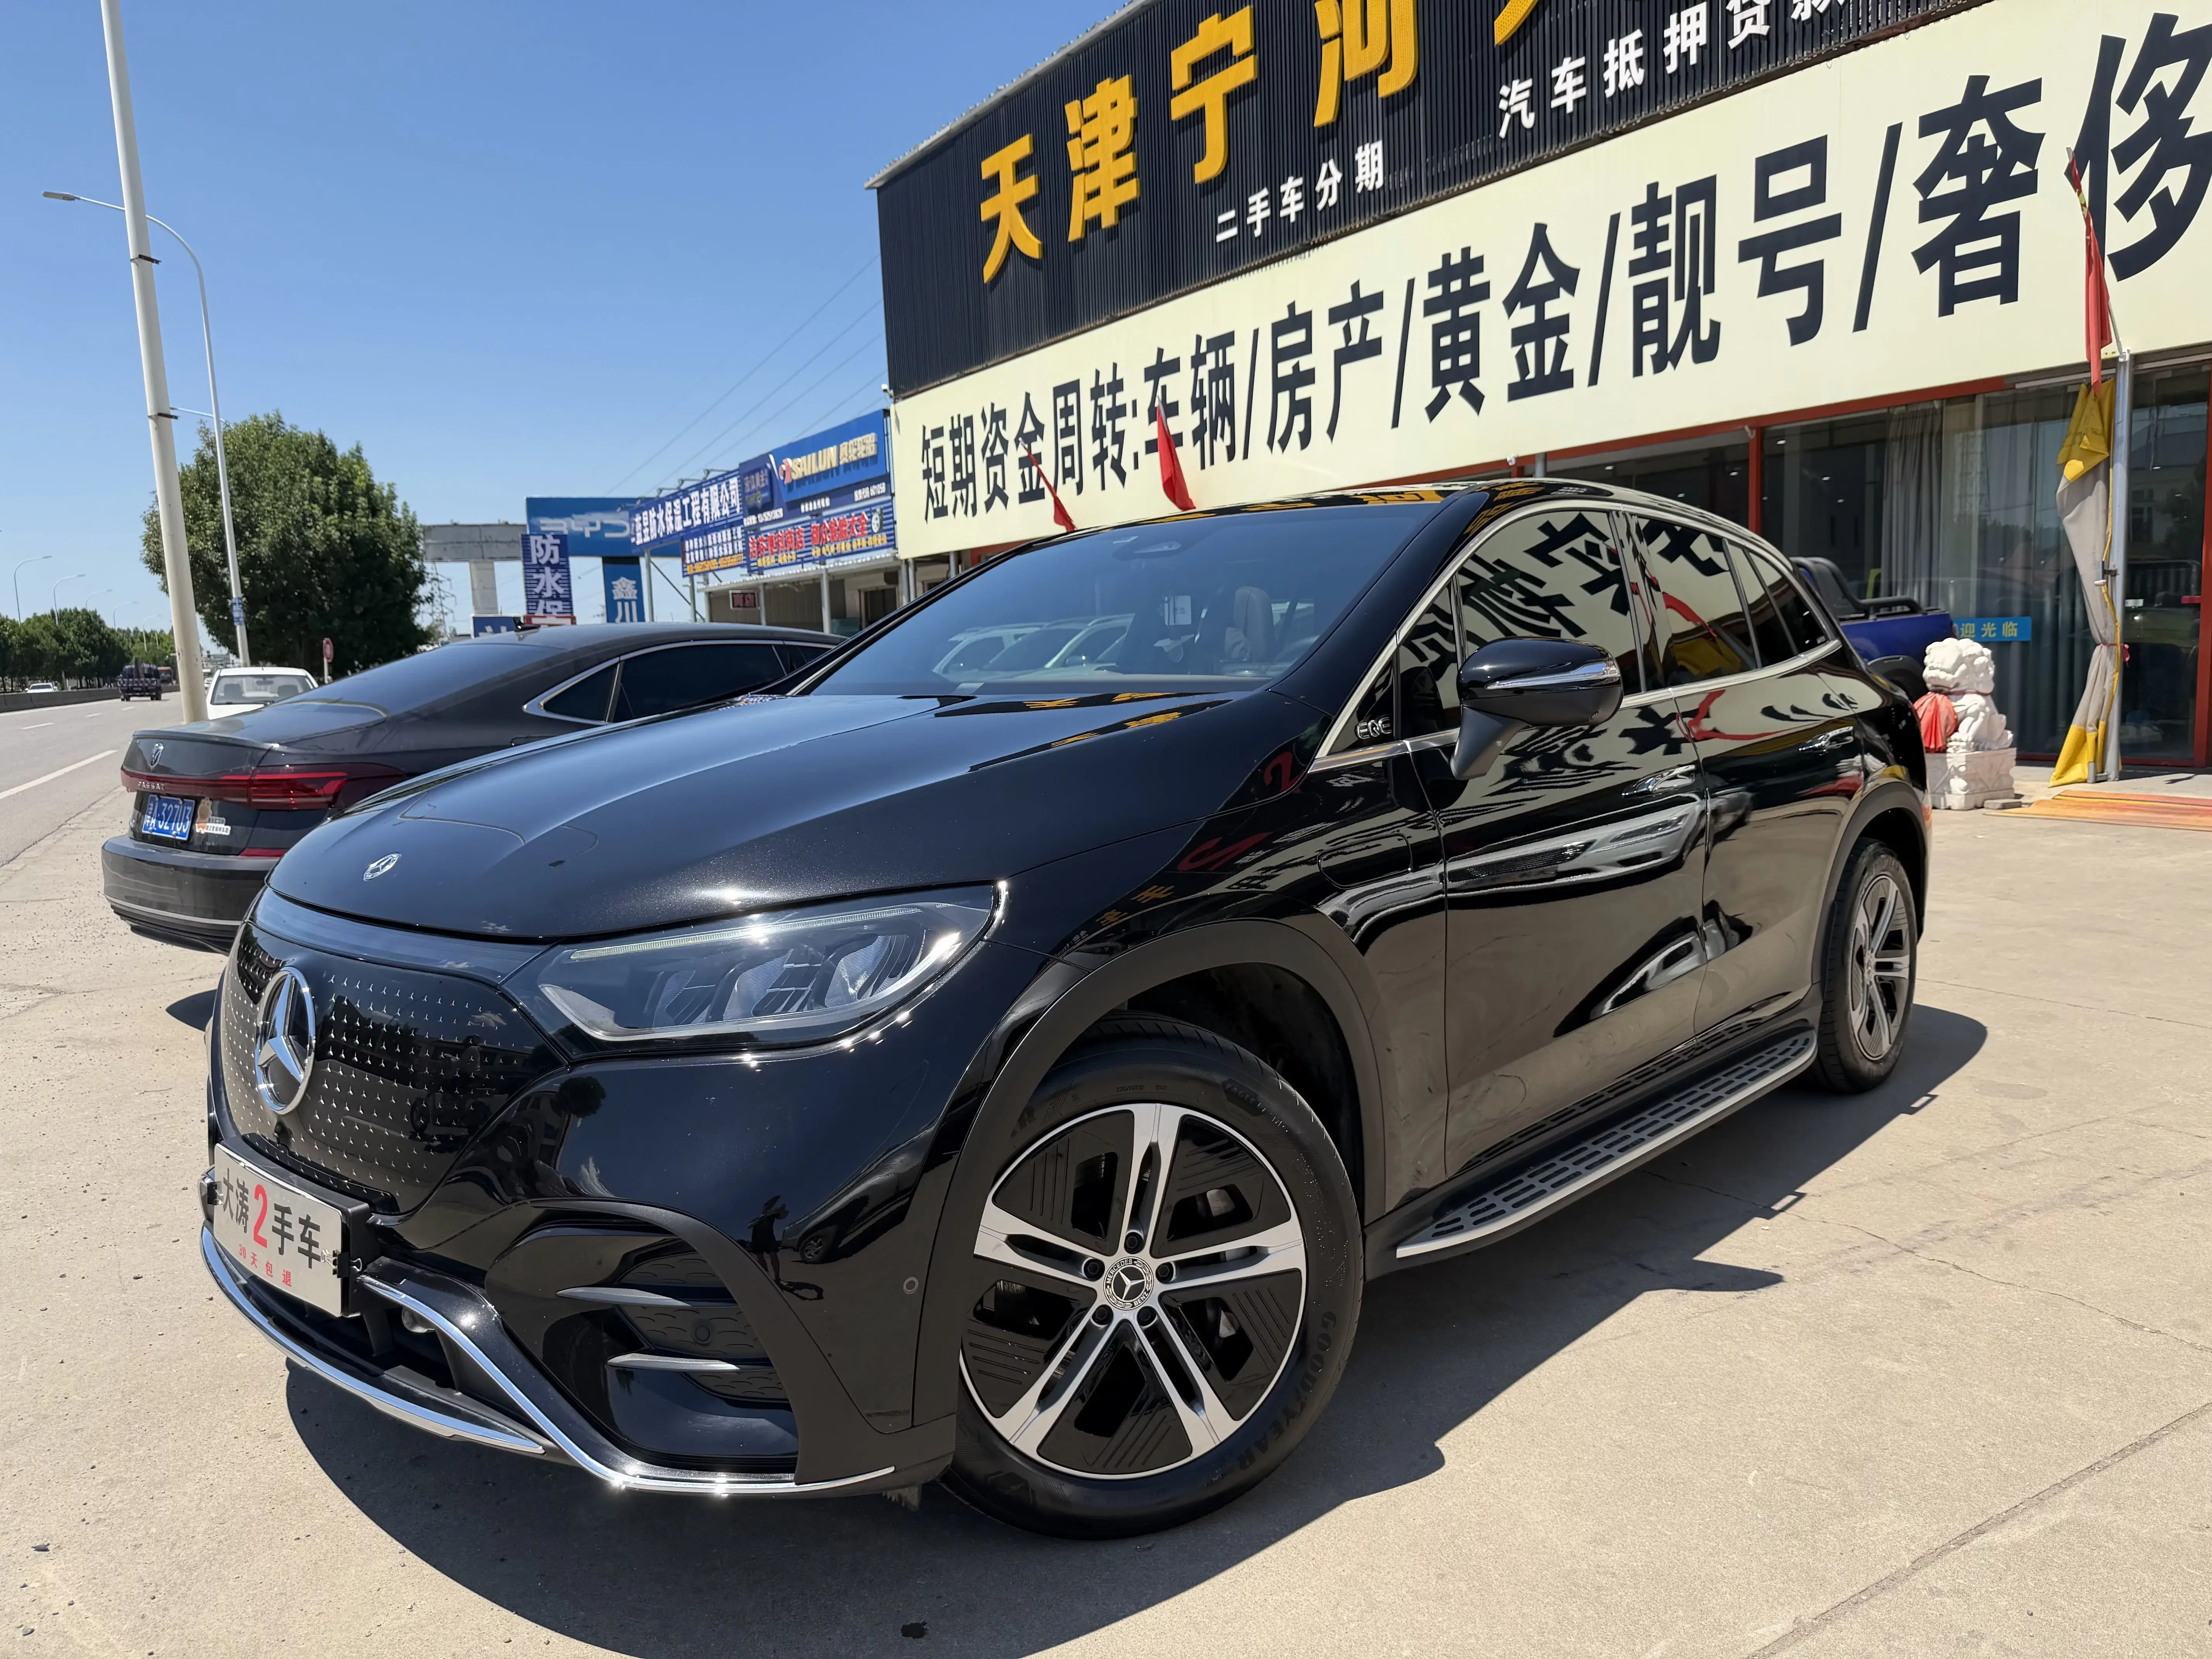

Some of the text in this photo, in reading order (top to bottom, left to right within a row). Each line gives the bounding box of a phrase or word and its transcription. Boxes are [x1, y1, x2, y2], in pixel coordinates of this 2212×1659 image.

[981, 0, 1538, 283] 天津宁河
[1215, 139, 1384, 244] 二手车分期
[791, 445, 838, 480] SAILUN
[1357, 716, 1393, 739] EQE
[138, 781, 165, 791] PASSAT
[222, 1167, 322, 1270] 大涛2手车
[239, 1244, 292, 1287] 30天包退
[1106, 1259, 1149, 1307] MERCEDES BENZ
[1237, 1310, 1337, 1471] GOODYEAR
